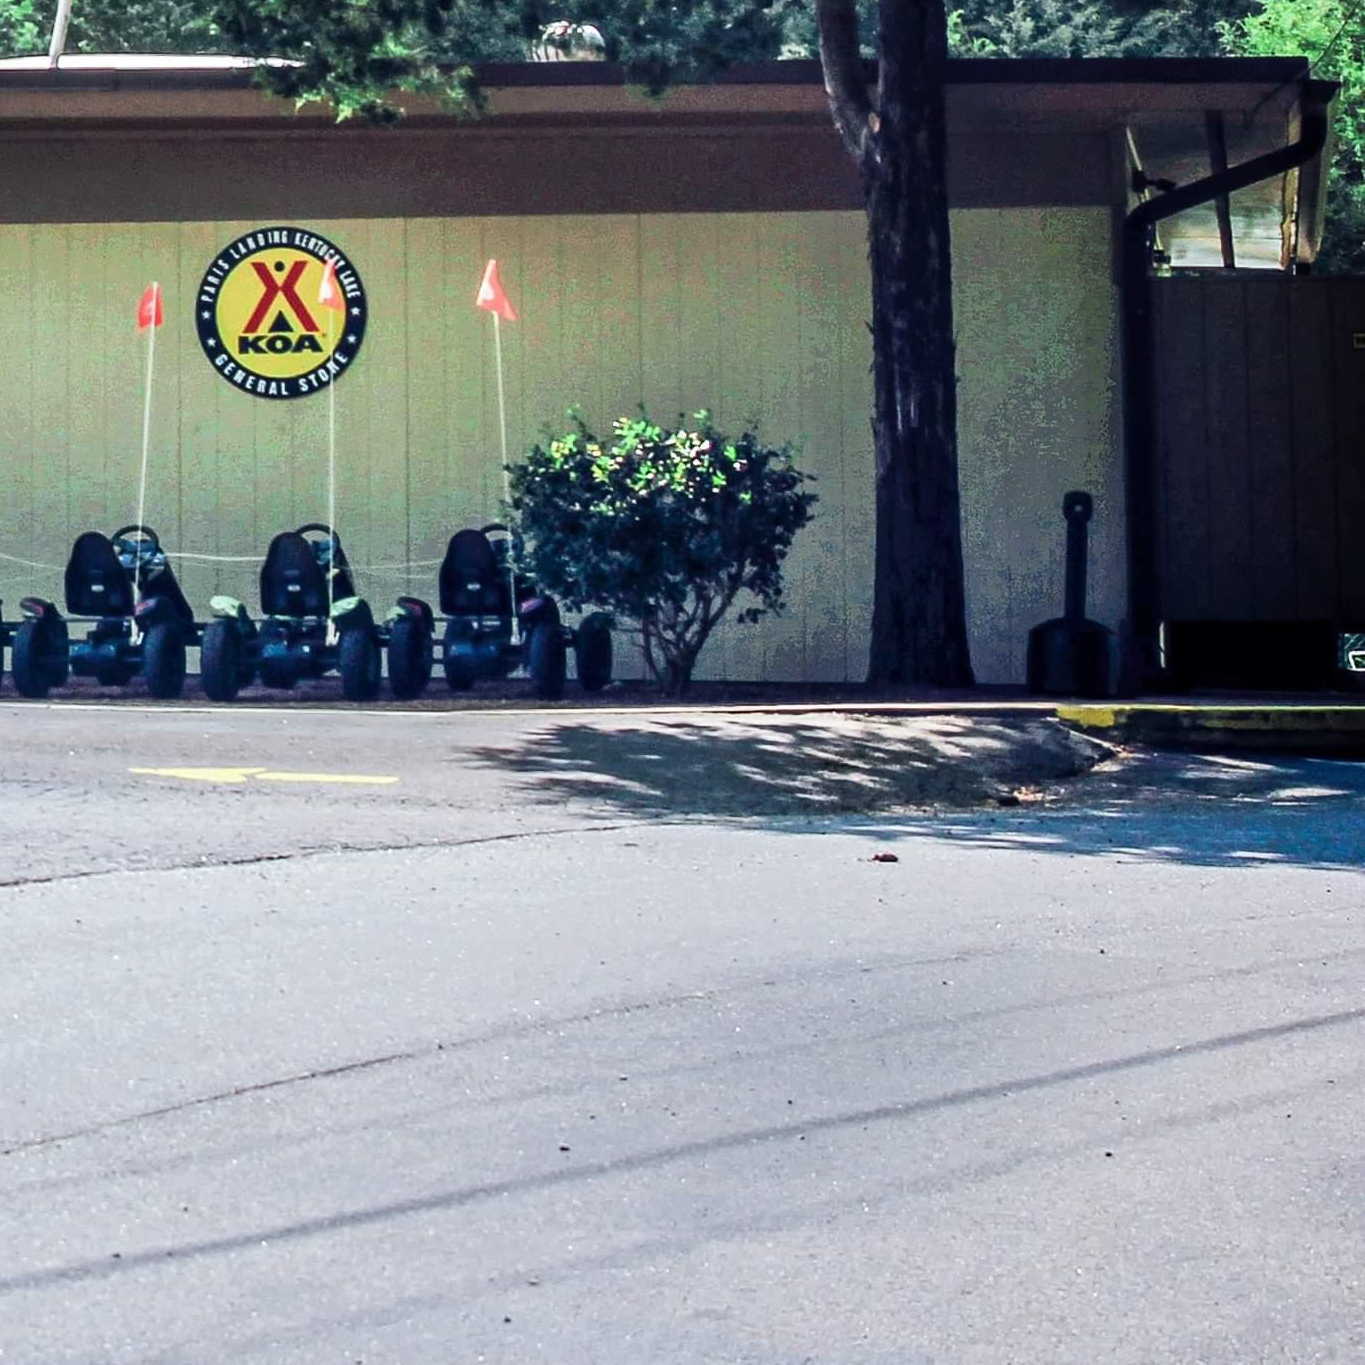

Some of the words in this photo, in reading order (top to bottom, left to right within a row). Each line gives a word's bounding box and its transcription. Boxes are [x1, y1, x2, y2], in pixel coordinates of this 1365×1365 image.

[201, 260, 229, 302] PARIS
[230, 231, 288, 259] LANDING
[340, 270, 361, 298] LAKE
[238, 334, 323, 354] KOA
[215, 354, 288, 395] GENERAL
[298, 351, 348, 391] STORE
